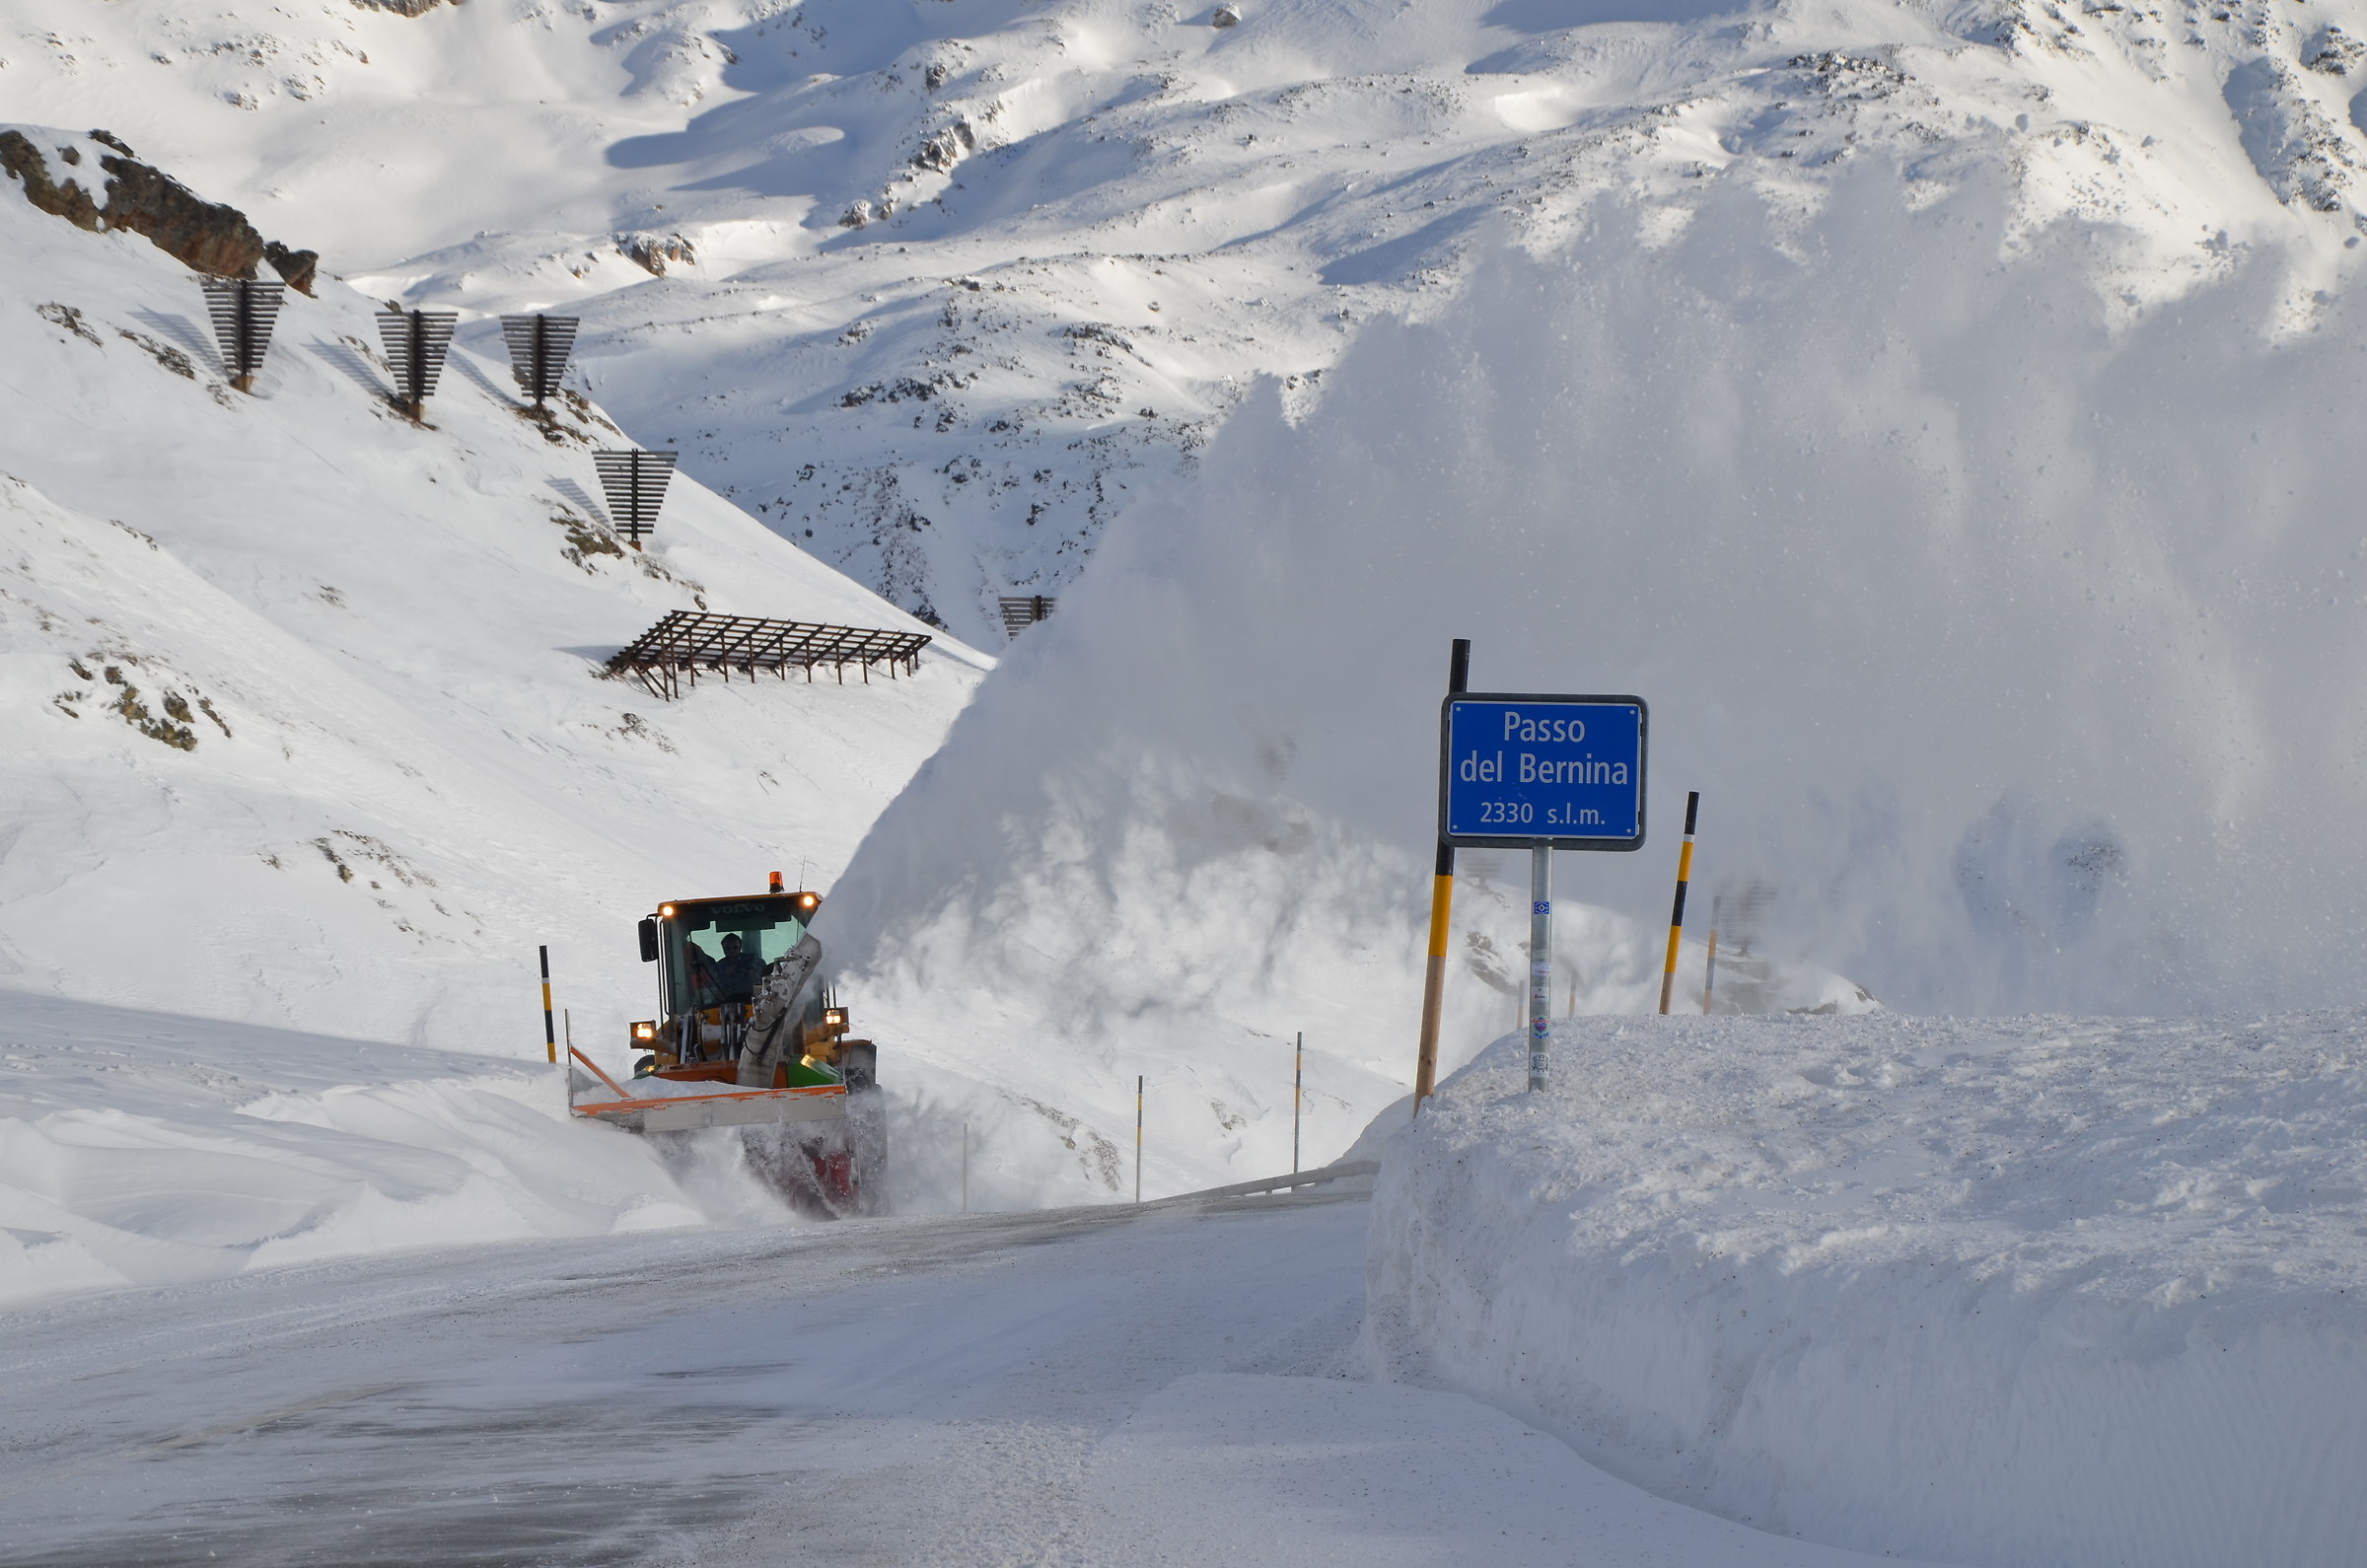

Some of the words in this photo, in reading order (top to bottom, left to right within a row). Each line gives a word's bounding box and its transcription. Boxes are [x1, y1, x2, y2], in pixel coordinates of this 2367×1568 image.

[1504, 711, 1586, 743] Passo
[1460, 749, 1503, 782] del
[1520, 752, 1628, 785] Bernina
[1479, 802, 1534, 823] 2330
[1546, 802, 1606, 825] s.l.m.
[711, 903, 765, 914] VOLVO
